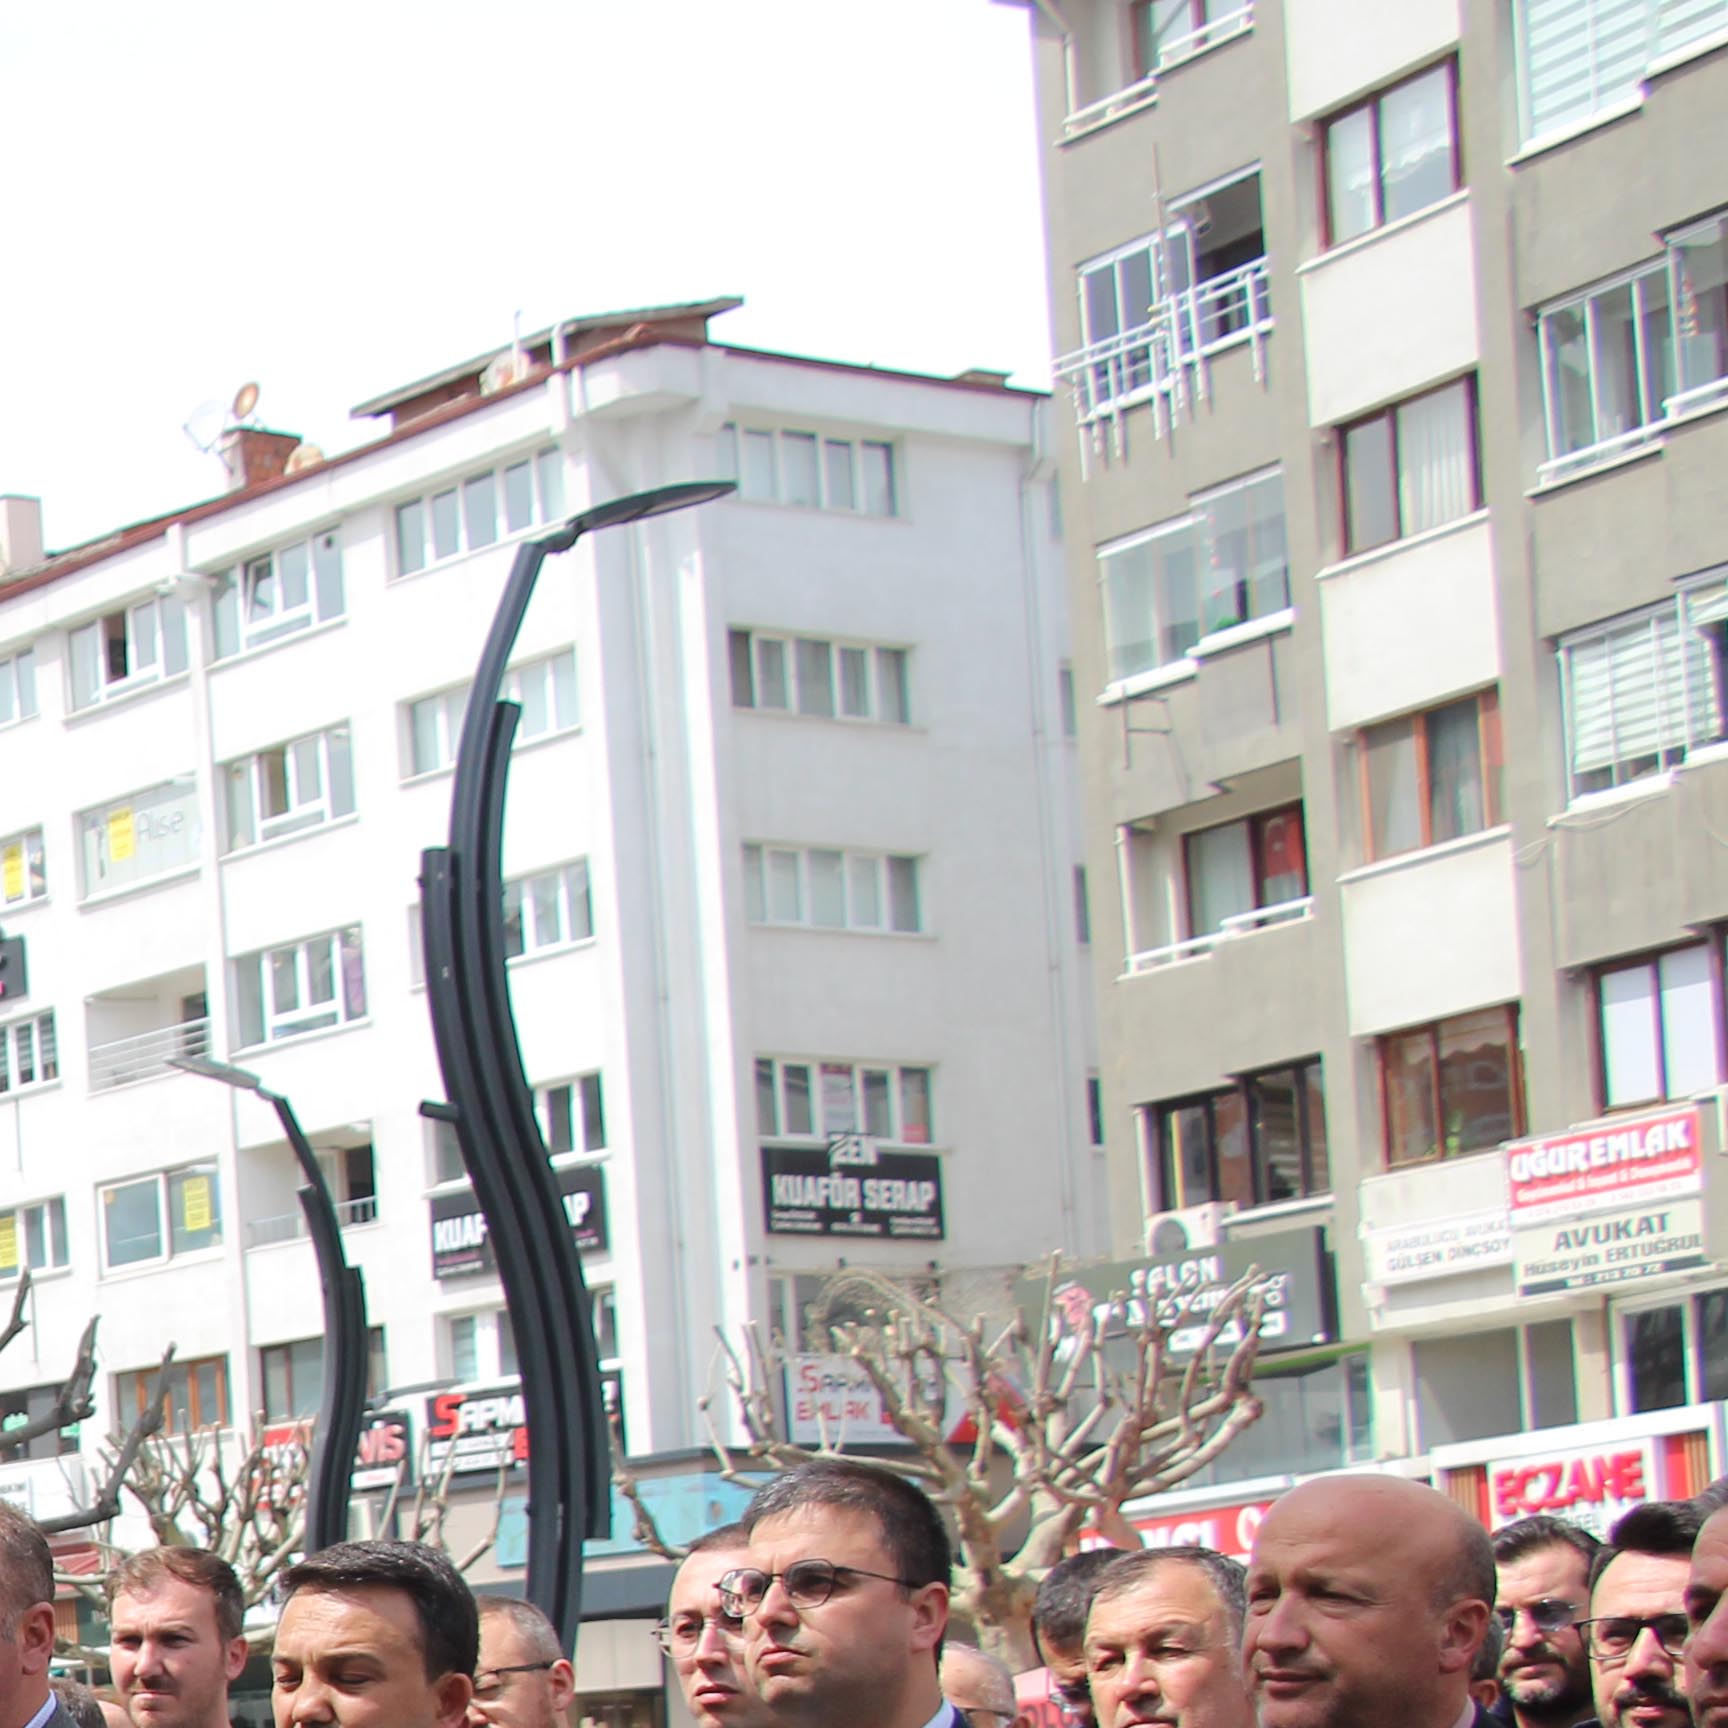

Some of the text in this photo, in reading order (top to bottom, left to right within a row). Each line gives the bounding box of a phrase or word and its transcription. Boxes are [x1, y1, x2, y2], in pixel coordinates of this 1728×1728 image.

[1510, 1142, 1589, 1182] UĞUR
[1590, 1120, 1691, 1163] EMLAK
[772, 1172, 935, 1211] KUAFÖR SERAP
[434, 1212, 488, 1252] KUAF
[1554, 1212, 1670, 1251] AVUKAT
[1495, 1450, 1646, 1515] ECZANE
